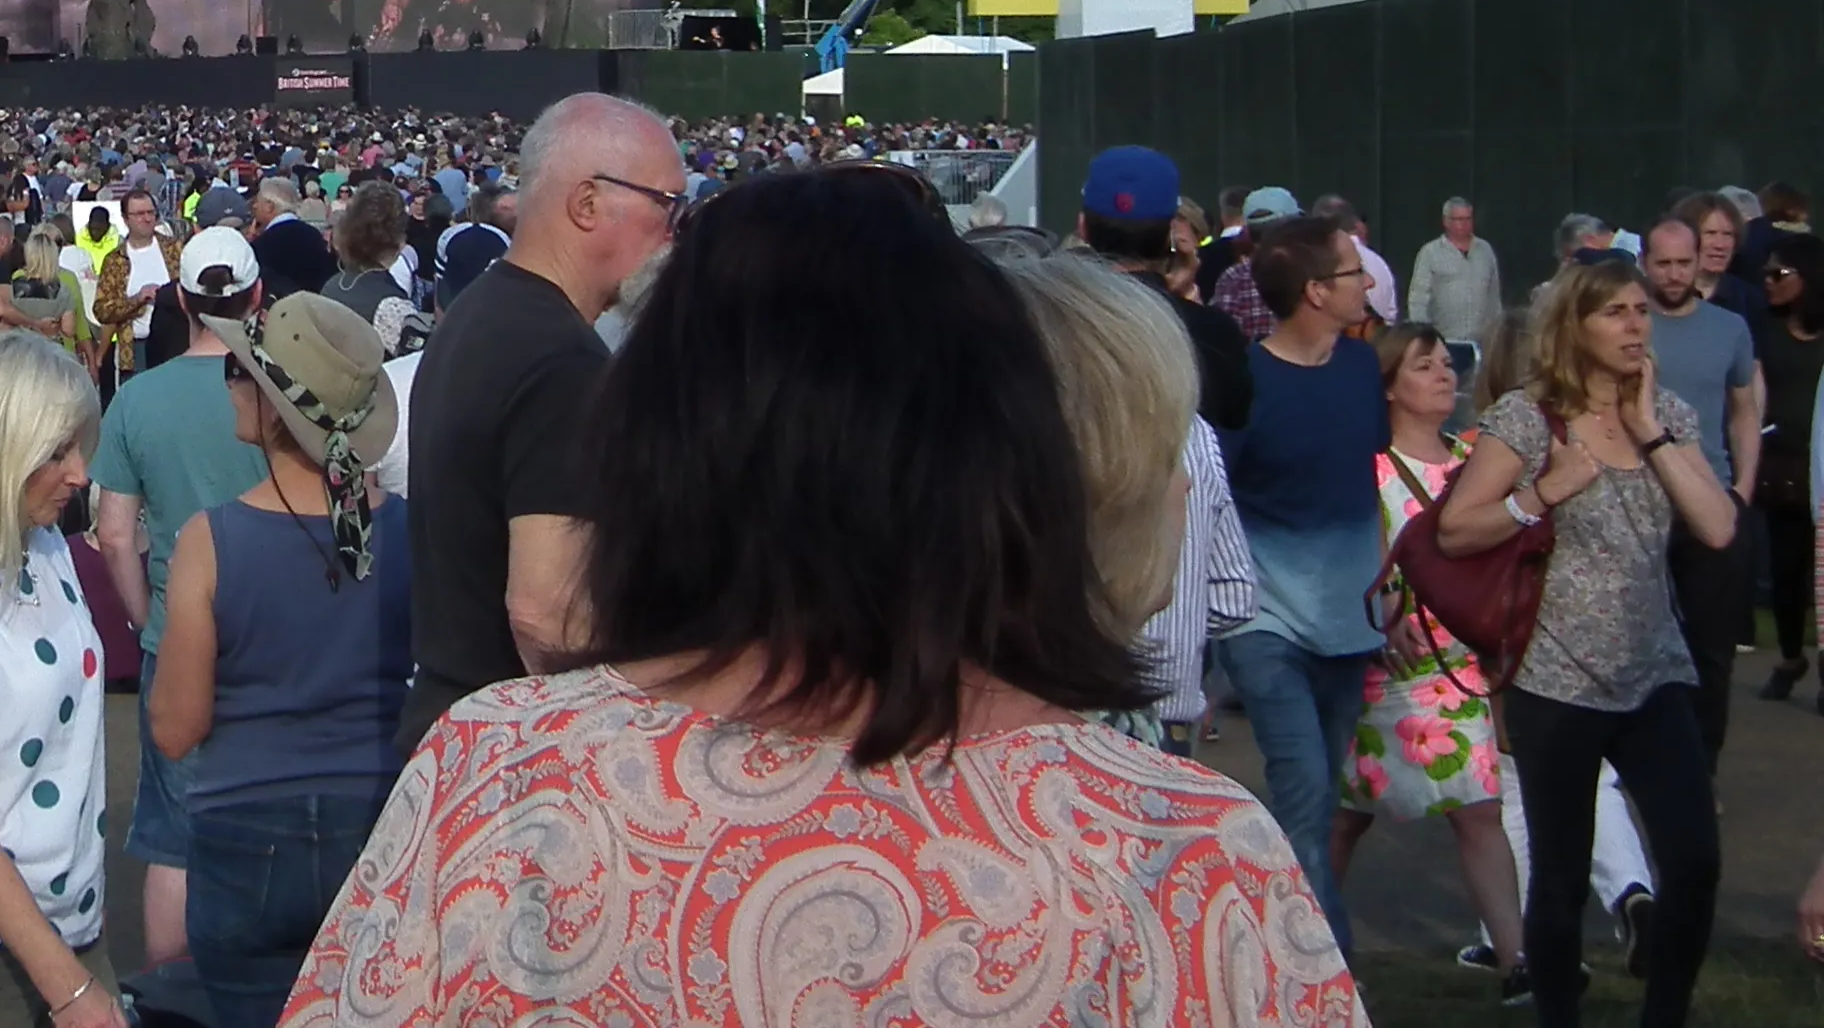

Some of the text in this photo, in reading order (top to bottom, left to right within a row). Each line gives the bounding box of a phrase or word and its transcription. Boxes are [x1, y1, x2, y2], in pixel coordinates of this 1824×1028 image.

[278, 75, 350, 90] BRITISH SUMMER TIME
